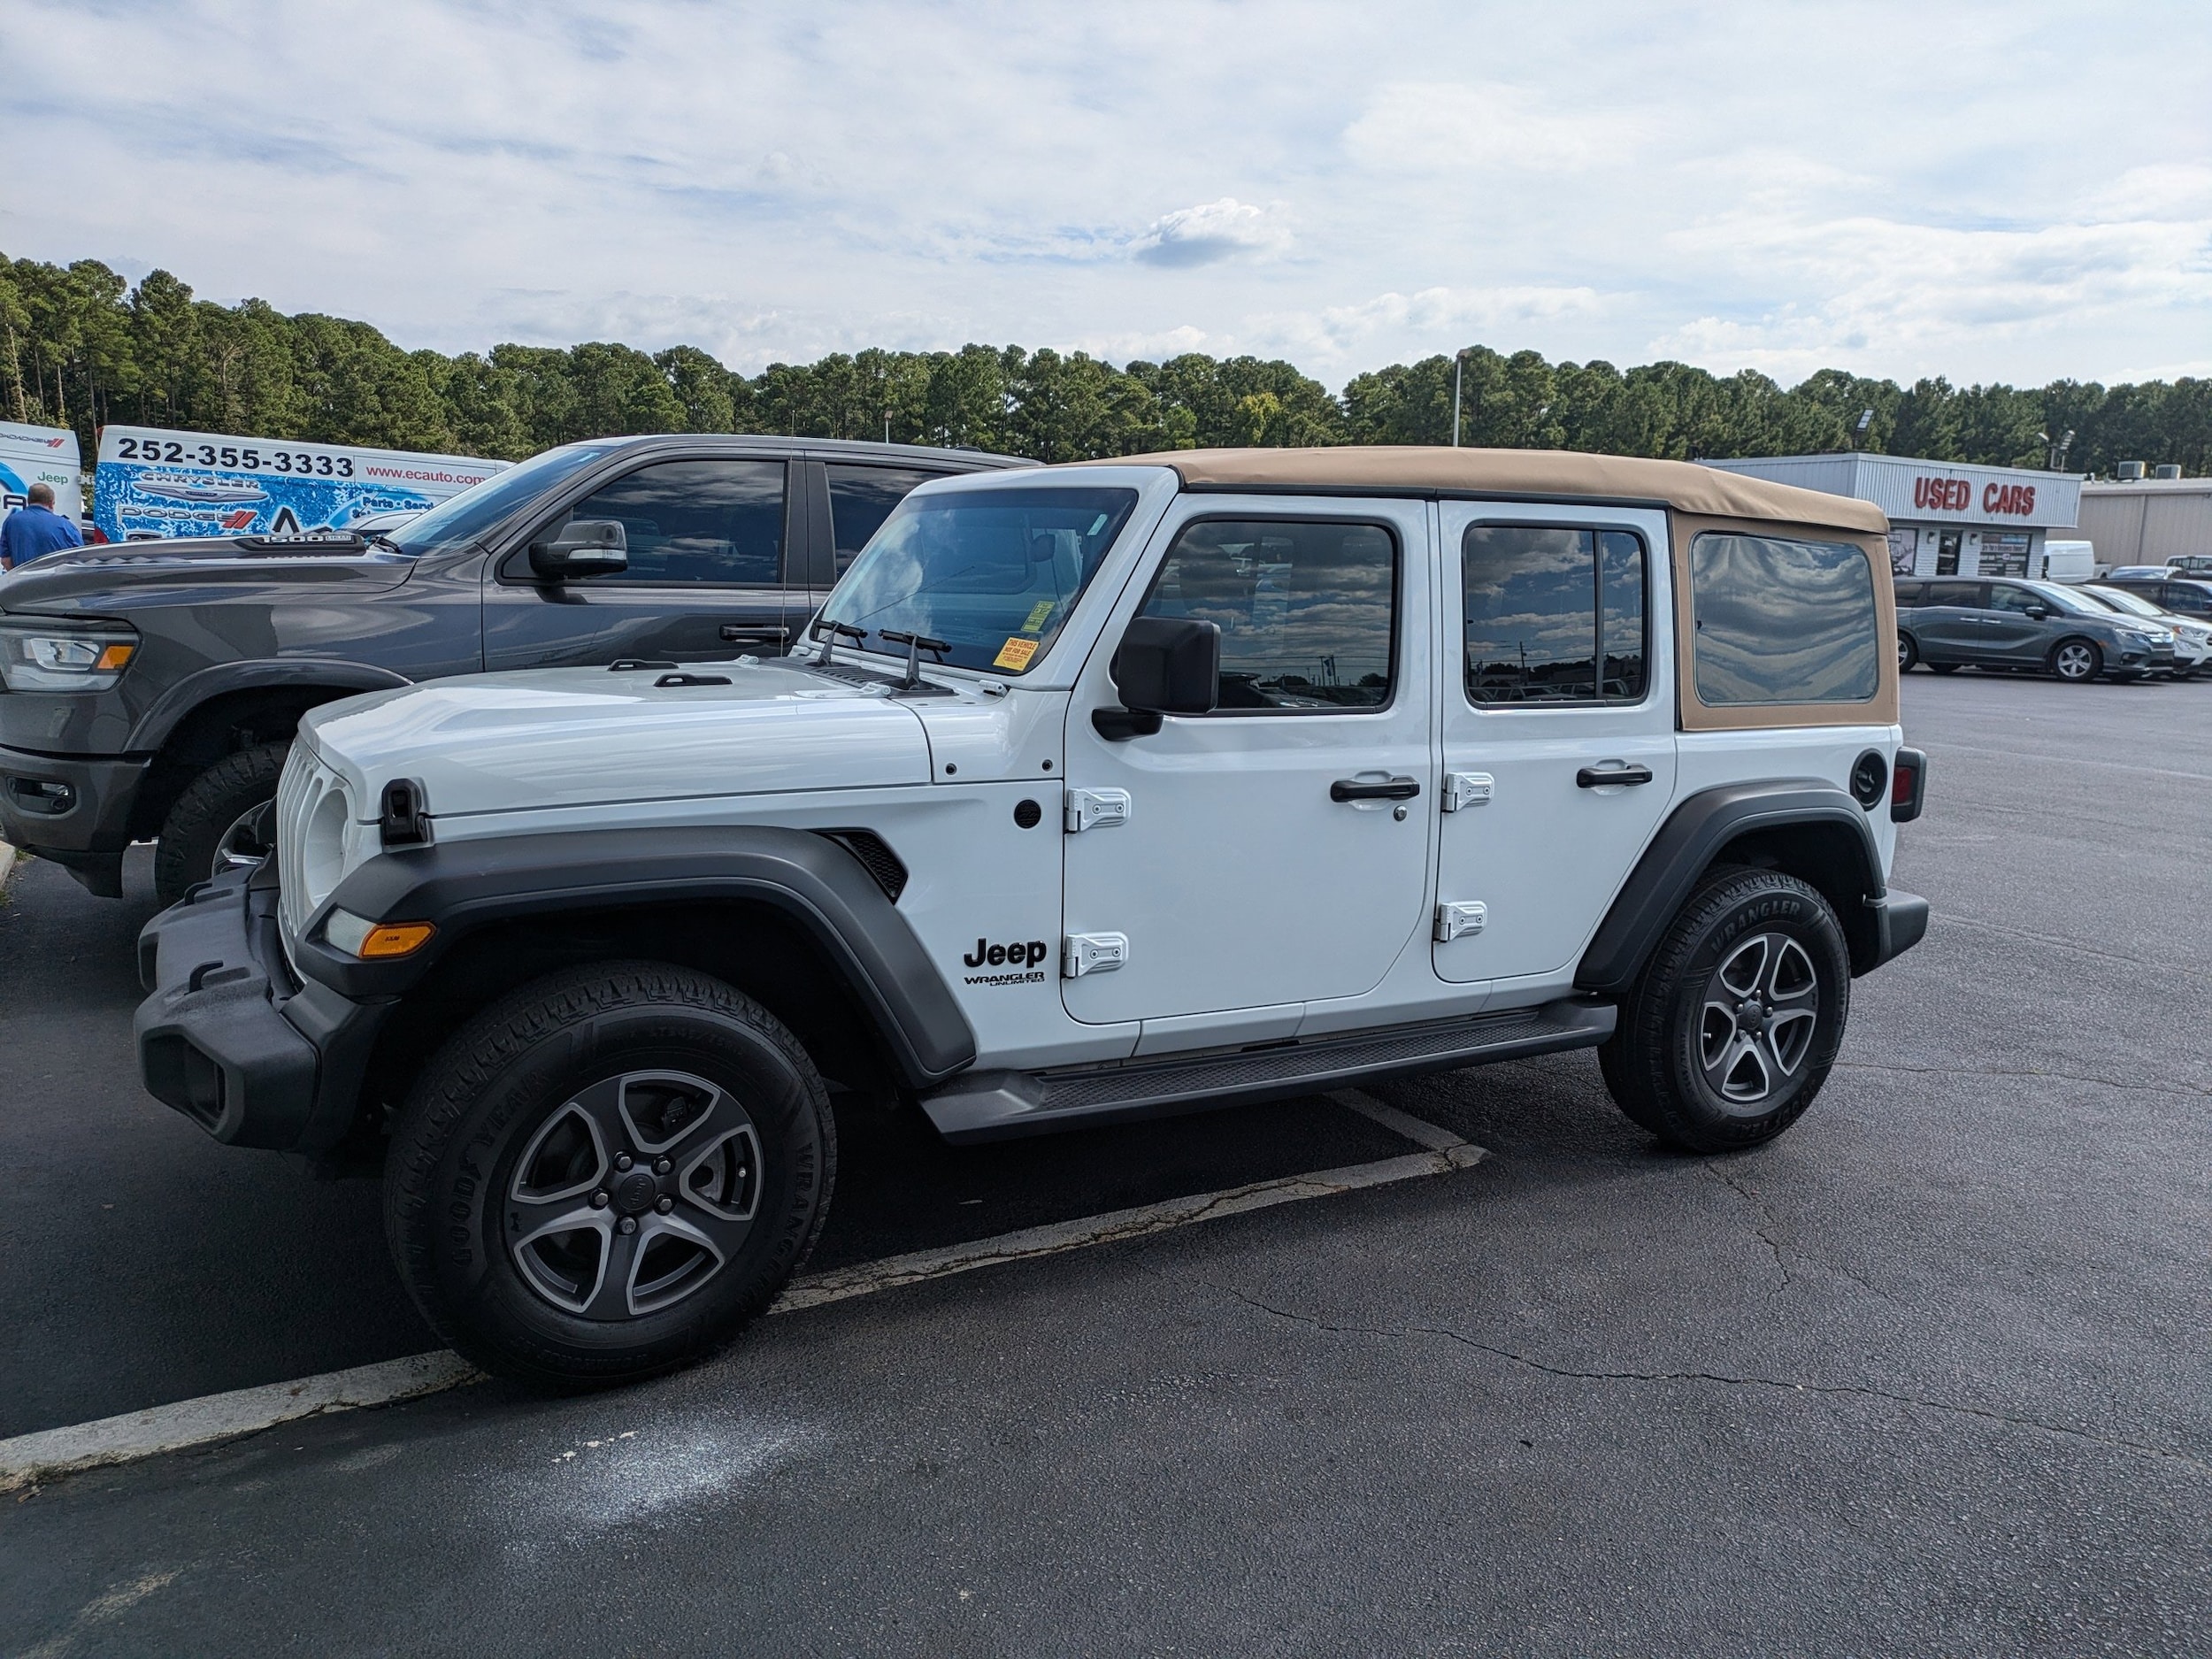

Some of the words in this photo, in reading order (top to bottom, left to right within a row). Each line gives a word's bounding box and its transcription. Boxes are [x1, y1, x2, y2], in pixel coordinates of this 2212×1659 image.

[119, 438, 353, 478] 252-355-3333
[37, 472, 68, 485] Jeep
[141, 472, 259, 488] CHRYSLER
[366, 465, 487, 486] www.ecauto.com
[363, 496, 394, 509] Parts
[1915, 477, 1970, 511] USED
[1983, 482, 2036, 516] CARS
[121, 508, 232, 523] DODGE
[263, 534, 324, 543] 1500
[1018, 641, 1037, 650] VEHICLE
[1710, 899, 1801, 953] WRANGLER
[964, 938, 1047, 969] Jeep
[964, 972, 1044, 985] WRANGLER
[989, 978, 1045, 987] UNLIMITED
